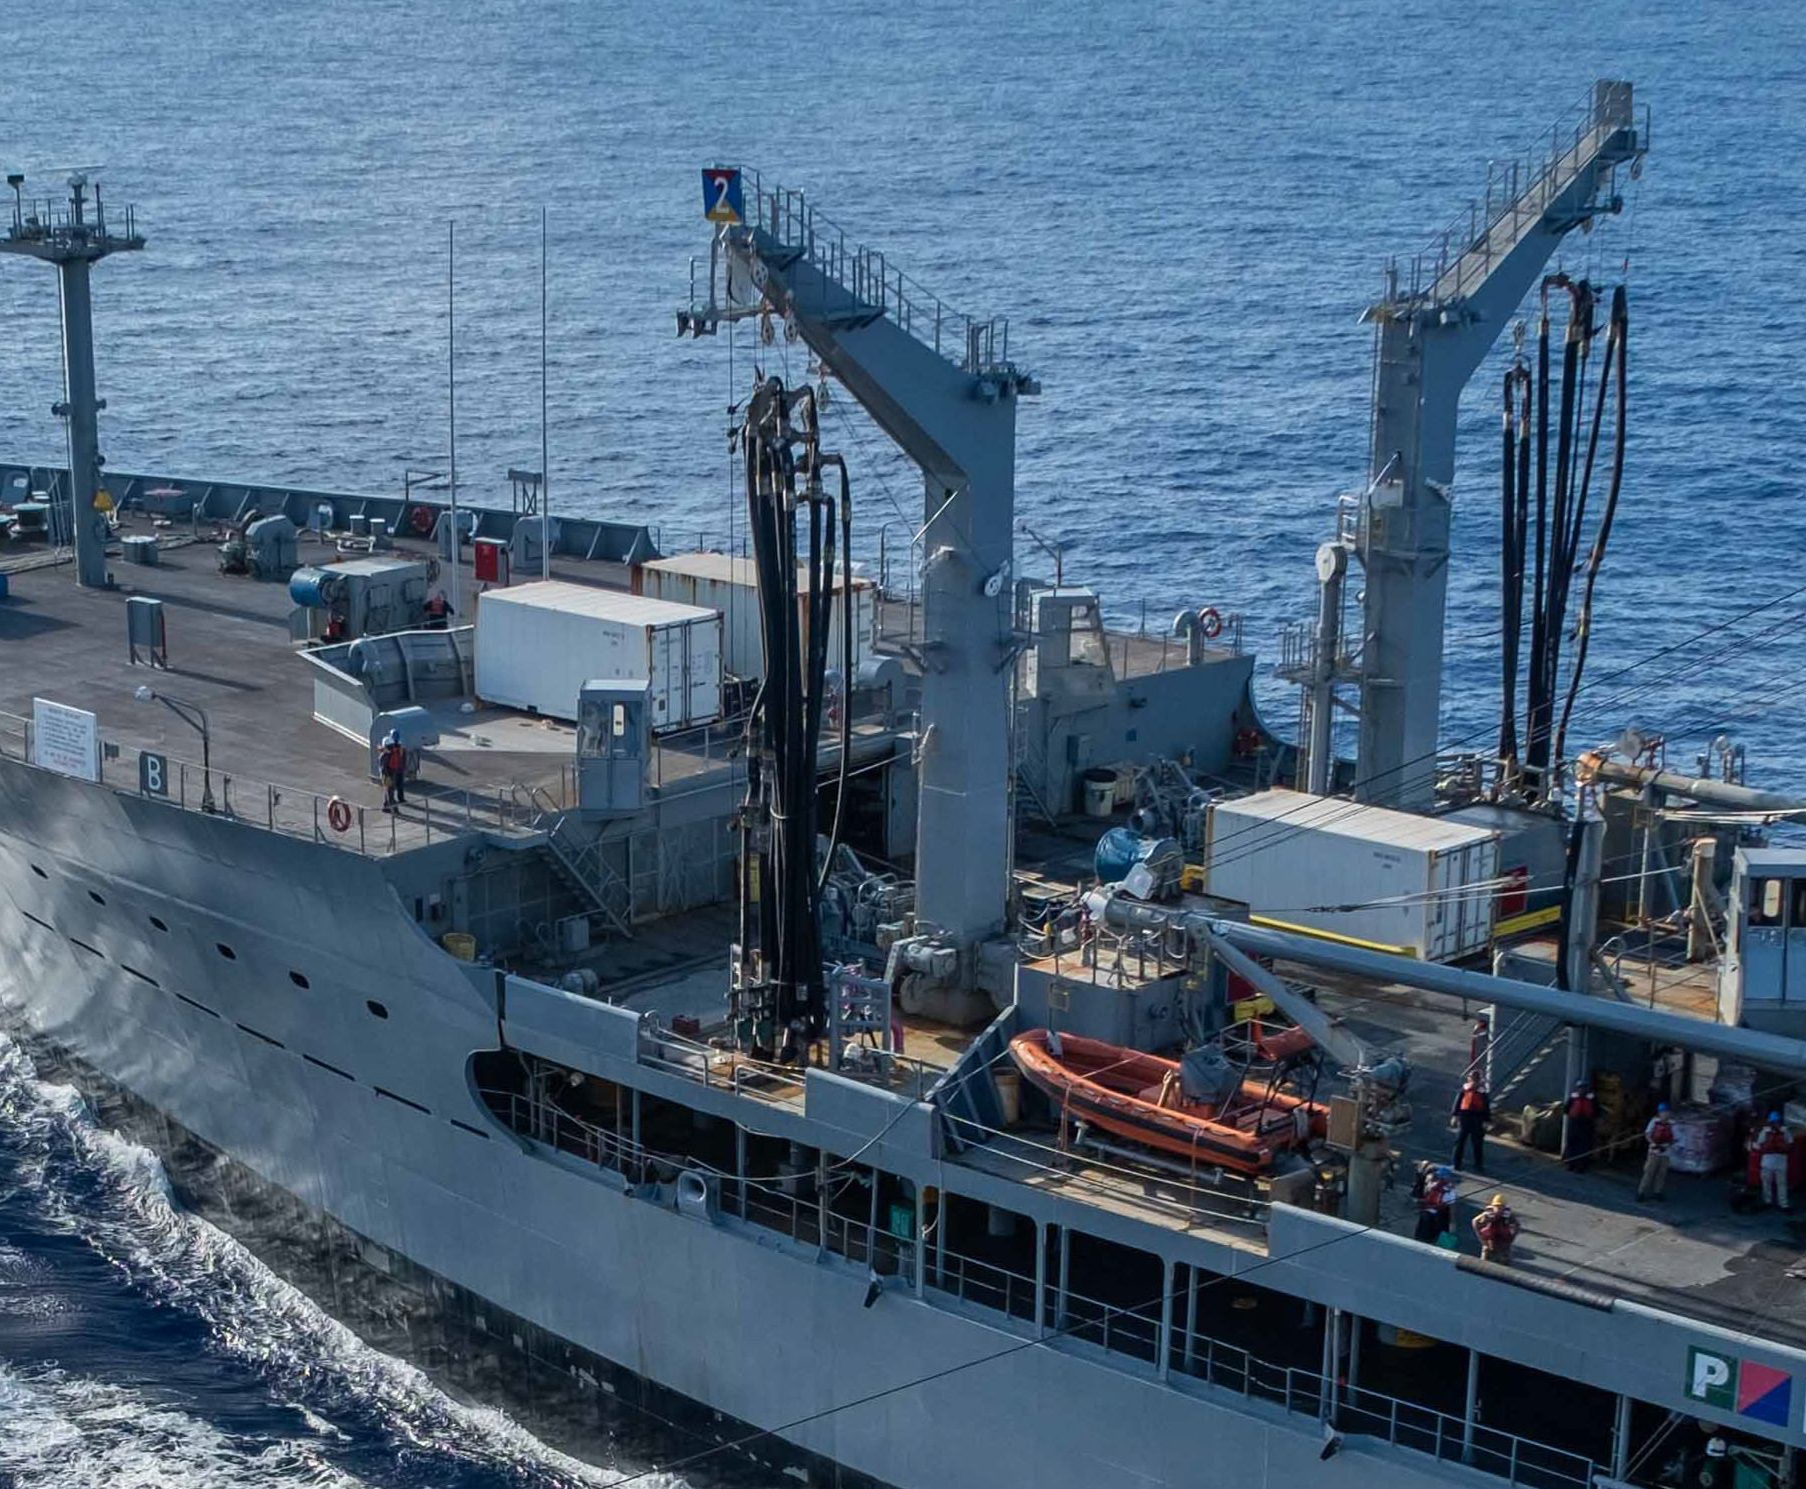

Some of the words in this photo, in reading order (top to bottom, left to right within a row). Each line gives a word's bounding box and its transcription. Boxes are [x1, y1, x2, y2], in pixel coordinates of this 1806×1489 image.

[714, 176, 730, 214] 2
[147, 756, 161, 790] B
[1692, 1352, 1730, 1398] P
